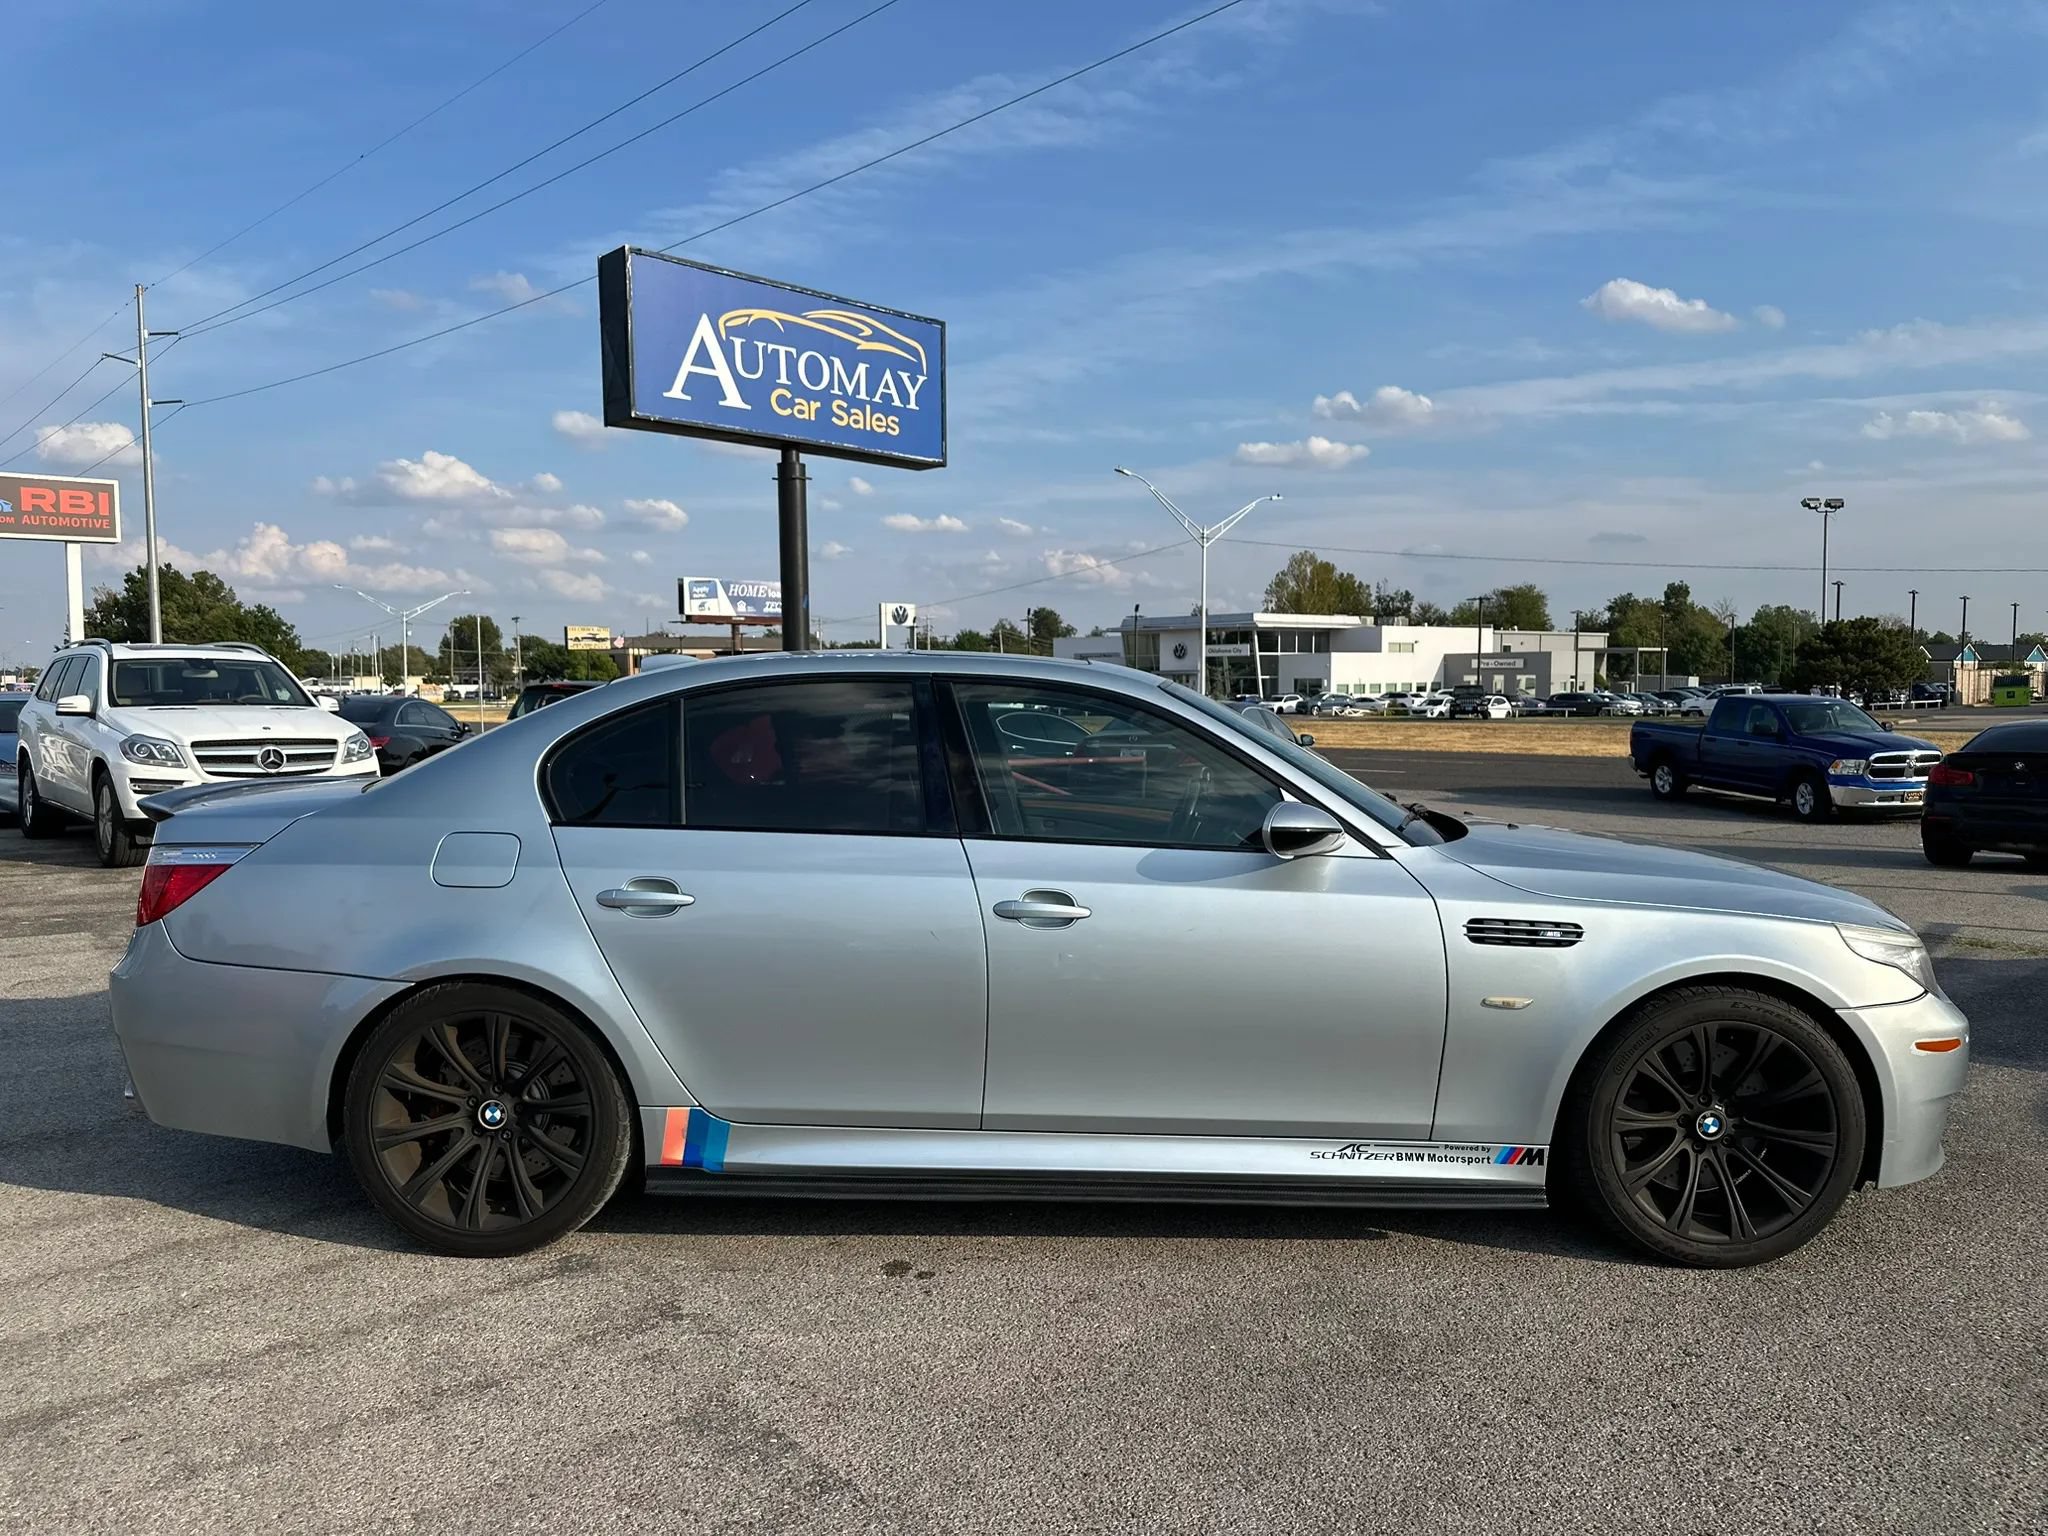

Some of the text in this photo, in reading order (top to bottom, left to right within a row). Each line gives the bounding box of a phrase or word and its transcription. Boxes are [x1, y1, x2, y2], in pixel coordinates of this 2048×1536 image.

[662, 313, 927, 410] AUTOMAY
[770, 388, 900, 436] Car Sales
[20, 487, 110, 516] RBI
[22, 515, 110, 528] AUTOMOTIVE
[728, 584, 782, 598] HOME loa
[1337, 1143, 1370, 1152] AC
[1444, 1144, 1491, 1153] Powered by
[1310, 1151, 1395, 1160] SCHNITZER
[1396, 1152, 1491, 1165] BMW Motorsport
